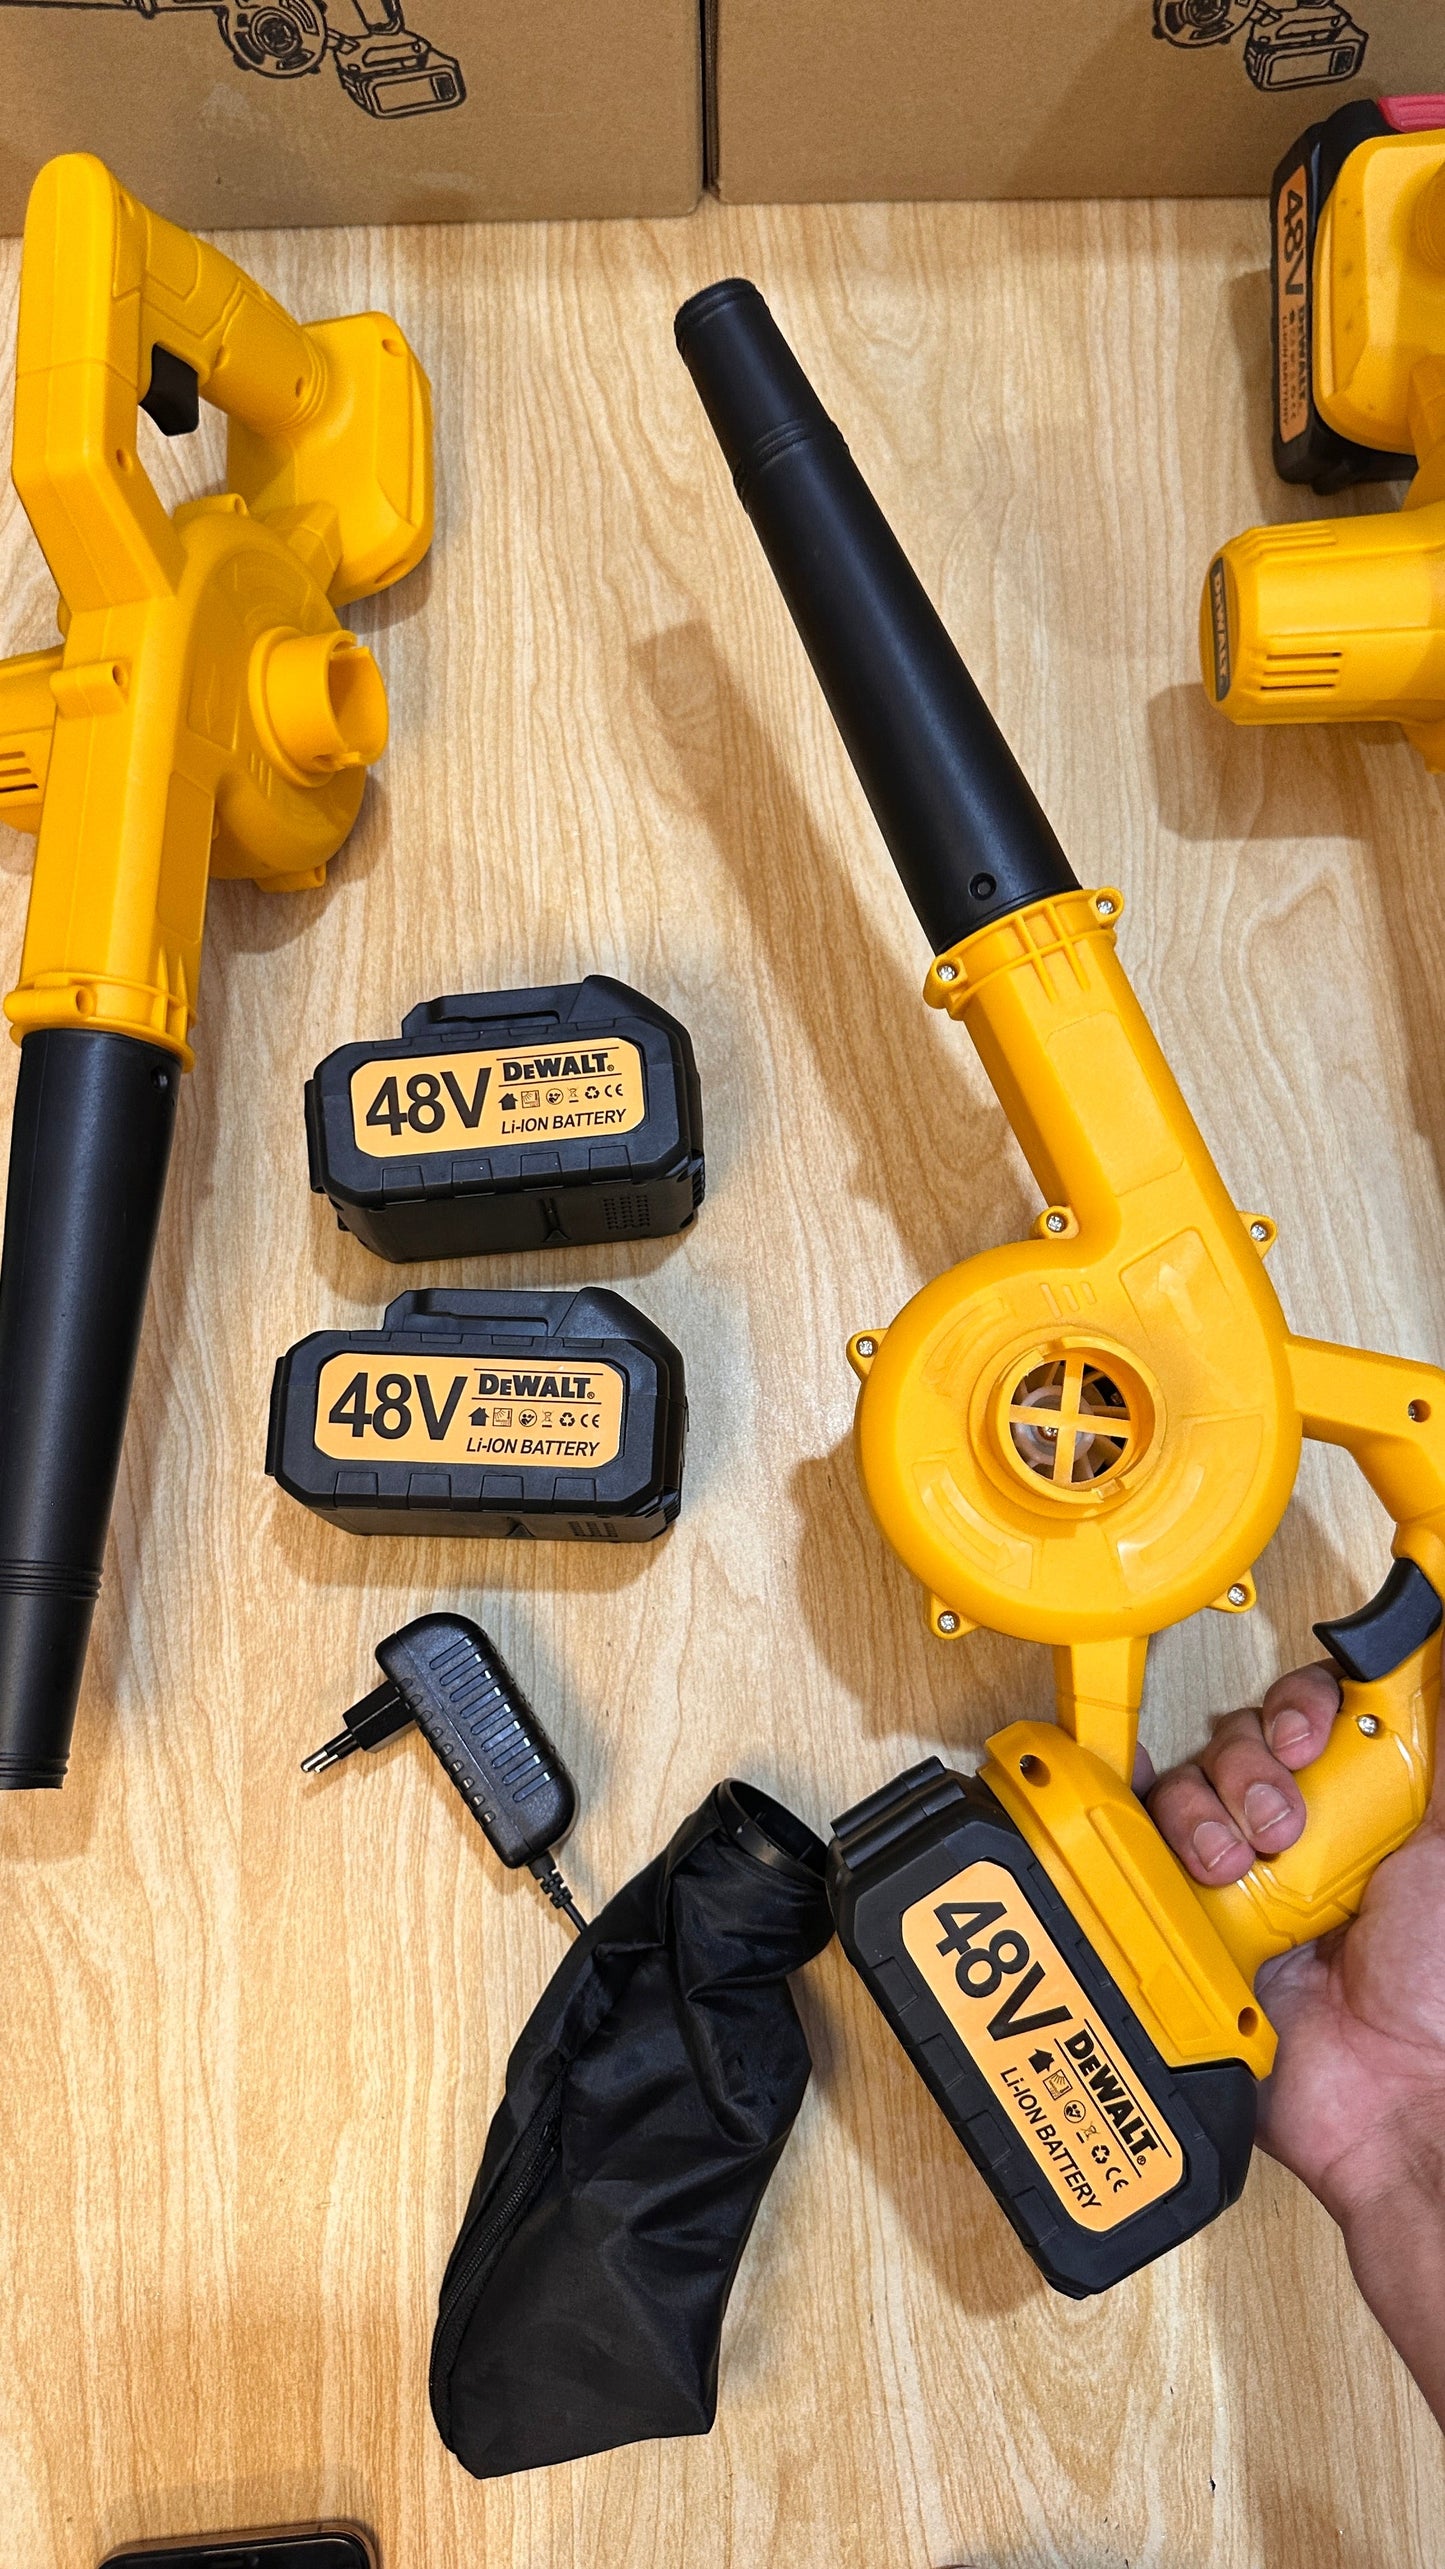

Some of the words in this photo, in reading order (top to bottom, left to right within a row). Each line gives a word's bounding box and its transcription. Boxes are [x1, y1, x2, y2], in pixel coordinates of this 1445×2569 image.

[1284, 189, 1305, 296] 48V
[1214, 572, 1227, 677] DEWALT
[365, 1067, 492, 1136] 48V
[502, 1053, 608, 1082] DEWALT
[501, 1116, 549, 1135] Li-ION
[552, 1108, 627, 1129] BATTERY
[328, 1372, 468, 1441] 48V
[478, 1373, 591, 1399] DEWALT
[466, 1437, 518, 1454] Li-ION
[520, 1439, 600, 1457] BATTERY
[932, 1901, 1074, 2042] 48V
[1063, 2027, 1158, 2153] DEWALT
[1000, 2066, 1044, 2129] Li-ION
[1036, 2125, 1101, 2210] BATTERY
